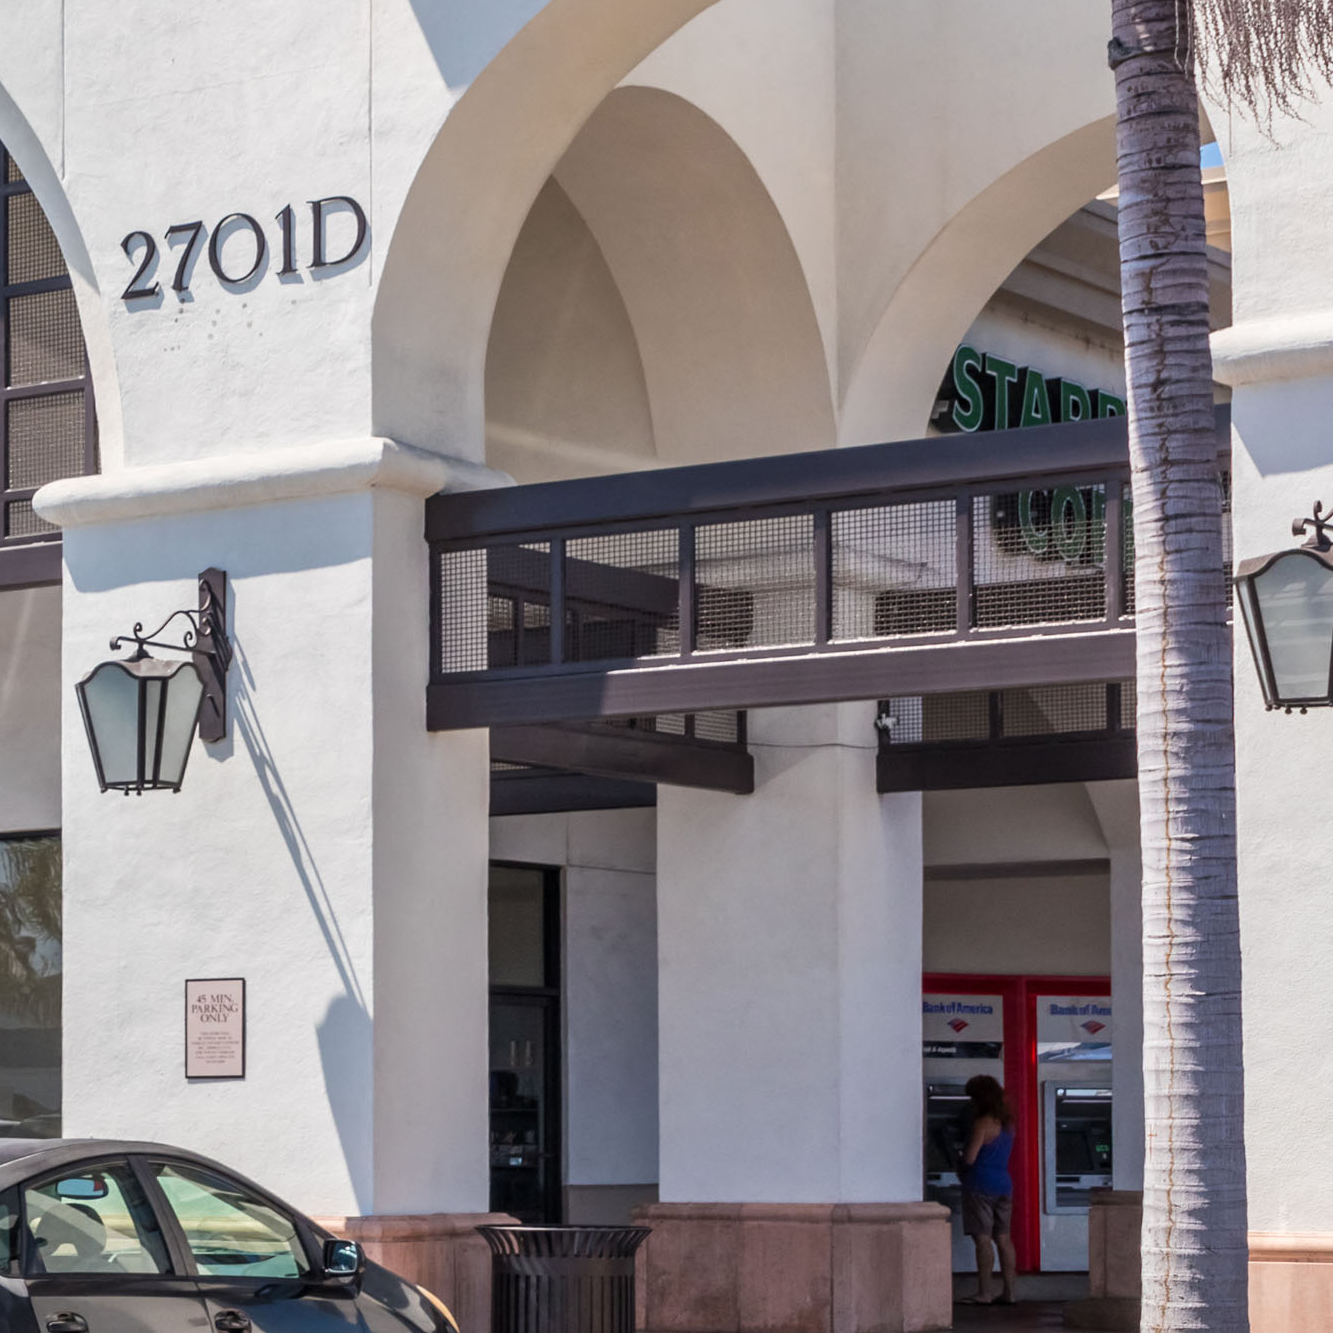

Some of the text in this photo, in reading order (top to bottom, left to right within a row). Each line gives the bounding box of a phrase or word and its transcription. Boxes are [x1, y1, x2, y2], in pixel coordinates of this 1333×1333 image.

[120, 195, 368, 300] 2701D
[191, 1003, 239, 1014] PARKING
[956, 1001, 994, 1015] America
[199, 1013, 230, 1023] ONLY
